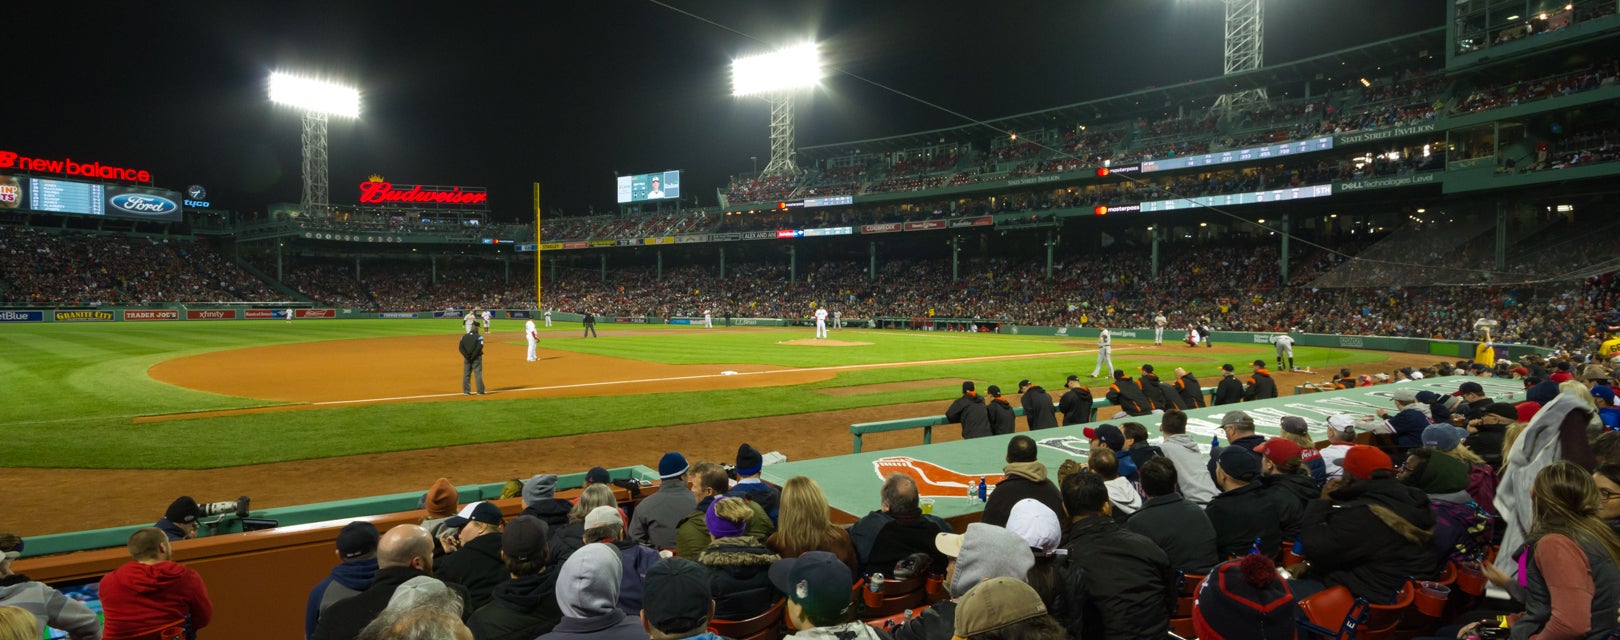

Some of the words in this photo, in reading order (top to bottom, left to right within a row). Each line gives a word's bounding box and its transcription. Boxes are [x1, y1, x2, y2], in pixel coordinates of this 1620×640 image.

[1341, 136, 1362, 144] STATE
[1364, 131, 1392, 140] STREET
[1394, 124, 1435, 136] PAVILION
[19, 156, 64, 174] new
[66, 158, 150, 182] balance
[1108, 166, 1139, 174] masterpass
[1364, 176, 1411, 188] Technologies
[1412, 174, 1433, 183] Level
[359, 181, 487, 204] Budweiser
[124, 195, 164, 212] Ford
[184, 200, 210, 208] tyco
[56, 312, 93, 320] GRANITE
[94, 311, 112, 320] CITY
[200, 310, 224, 319] xfinity
